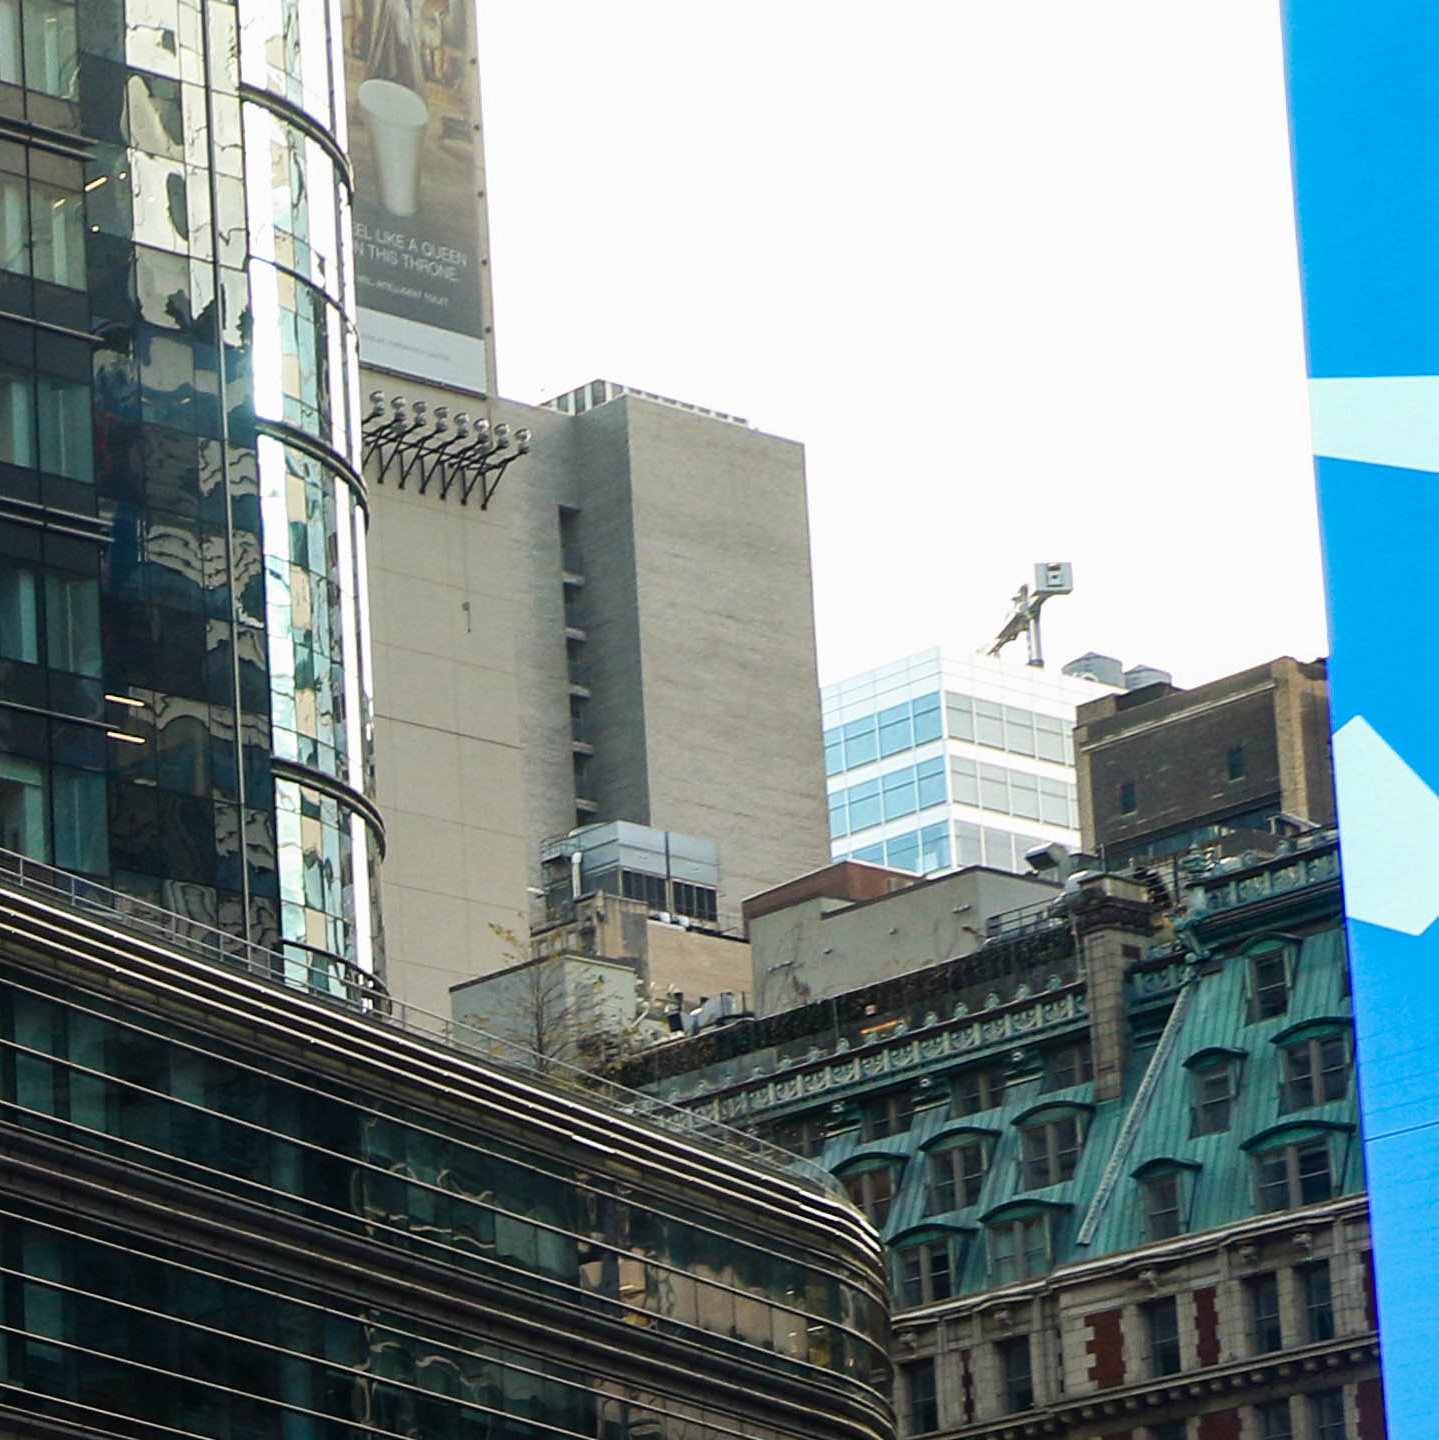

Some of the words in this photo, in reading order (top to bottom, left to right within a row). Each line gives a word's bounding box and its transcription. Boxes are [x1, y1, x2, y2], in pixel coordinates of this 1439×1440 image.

[367, 244, 400, 266] THIS
[376, 229, 405, 250] LIKE
[408, 238, 418, 253] A
[421, 240, 468, 268] QUEEN
